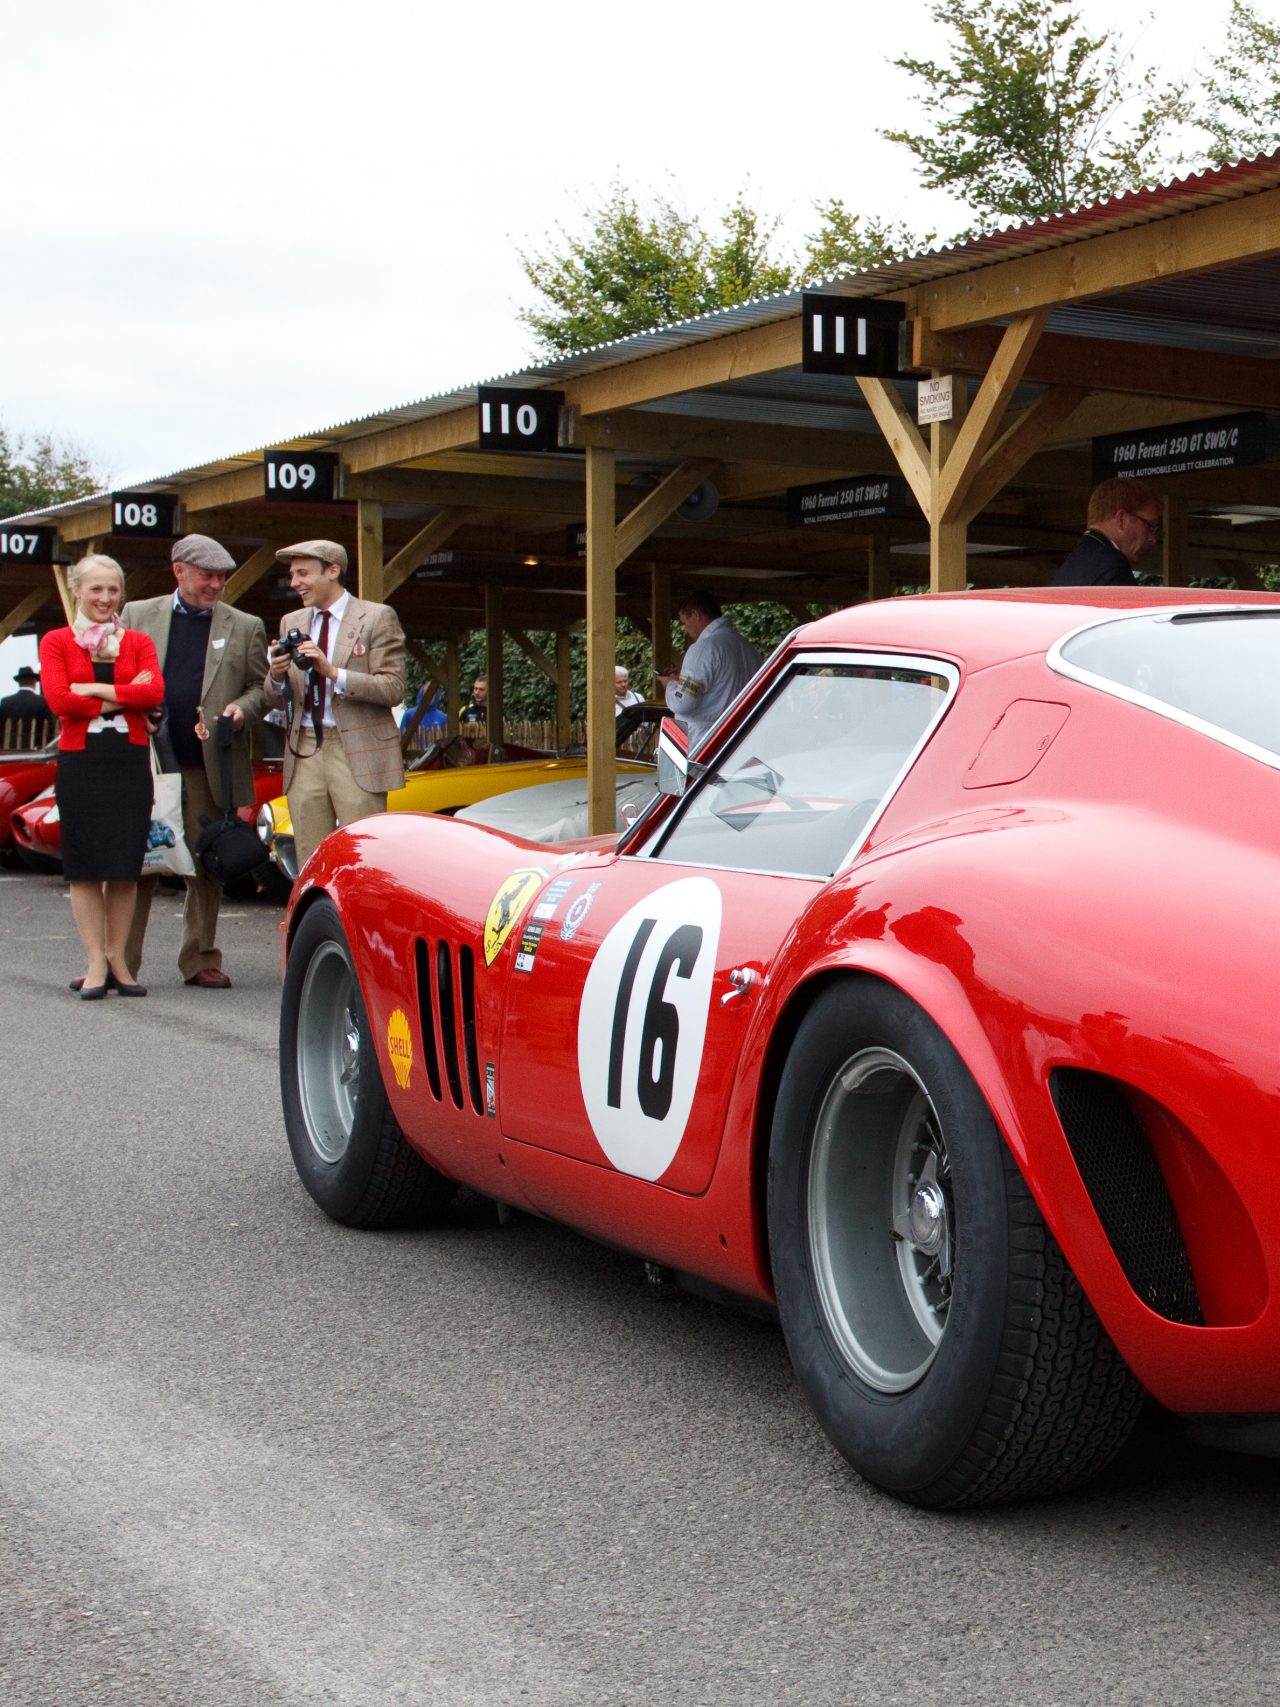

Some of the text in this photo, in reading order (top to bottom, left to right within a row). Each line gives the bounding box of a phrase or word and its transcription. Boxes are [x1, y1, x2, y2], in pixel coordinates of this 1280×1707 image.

[813, 314, 867, 356] 111
[920, 391, 950, 406] SMOKING
[929, 381, 940, 392] NO
[482, 402, 538, 436] 110
[1113, 428, 1239, 463] 1960 Ferrari 250 GT SWB/C
[267, 462, 316, 490] 109
[1136, 464, 1172, 478] AUTOMOBILE
[1171, 463, 1187, 472] CLUB
[1187, 461, 1195, 470] TT
[1194, 456, 1234, 470] CELEBRATION
[818, 491, 839, 509] Ferrari
[840, 489, 854, 505] 250
[855, 486, 865, 503] GT
[114, 502, 158, 527] 108
[0, 533, 39, 555] 107
[607, 918, 704, 1122] 16
[389, 1035, 410, 1060] SHELL
